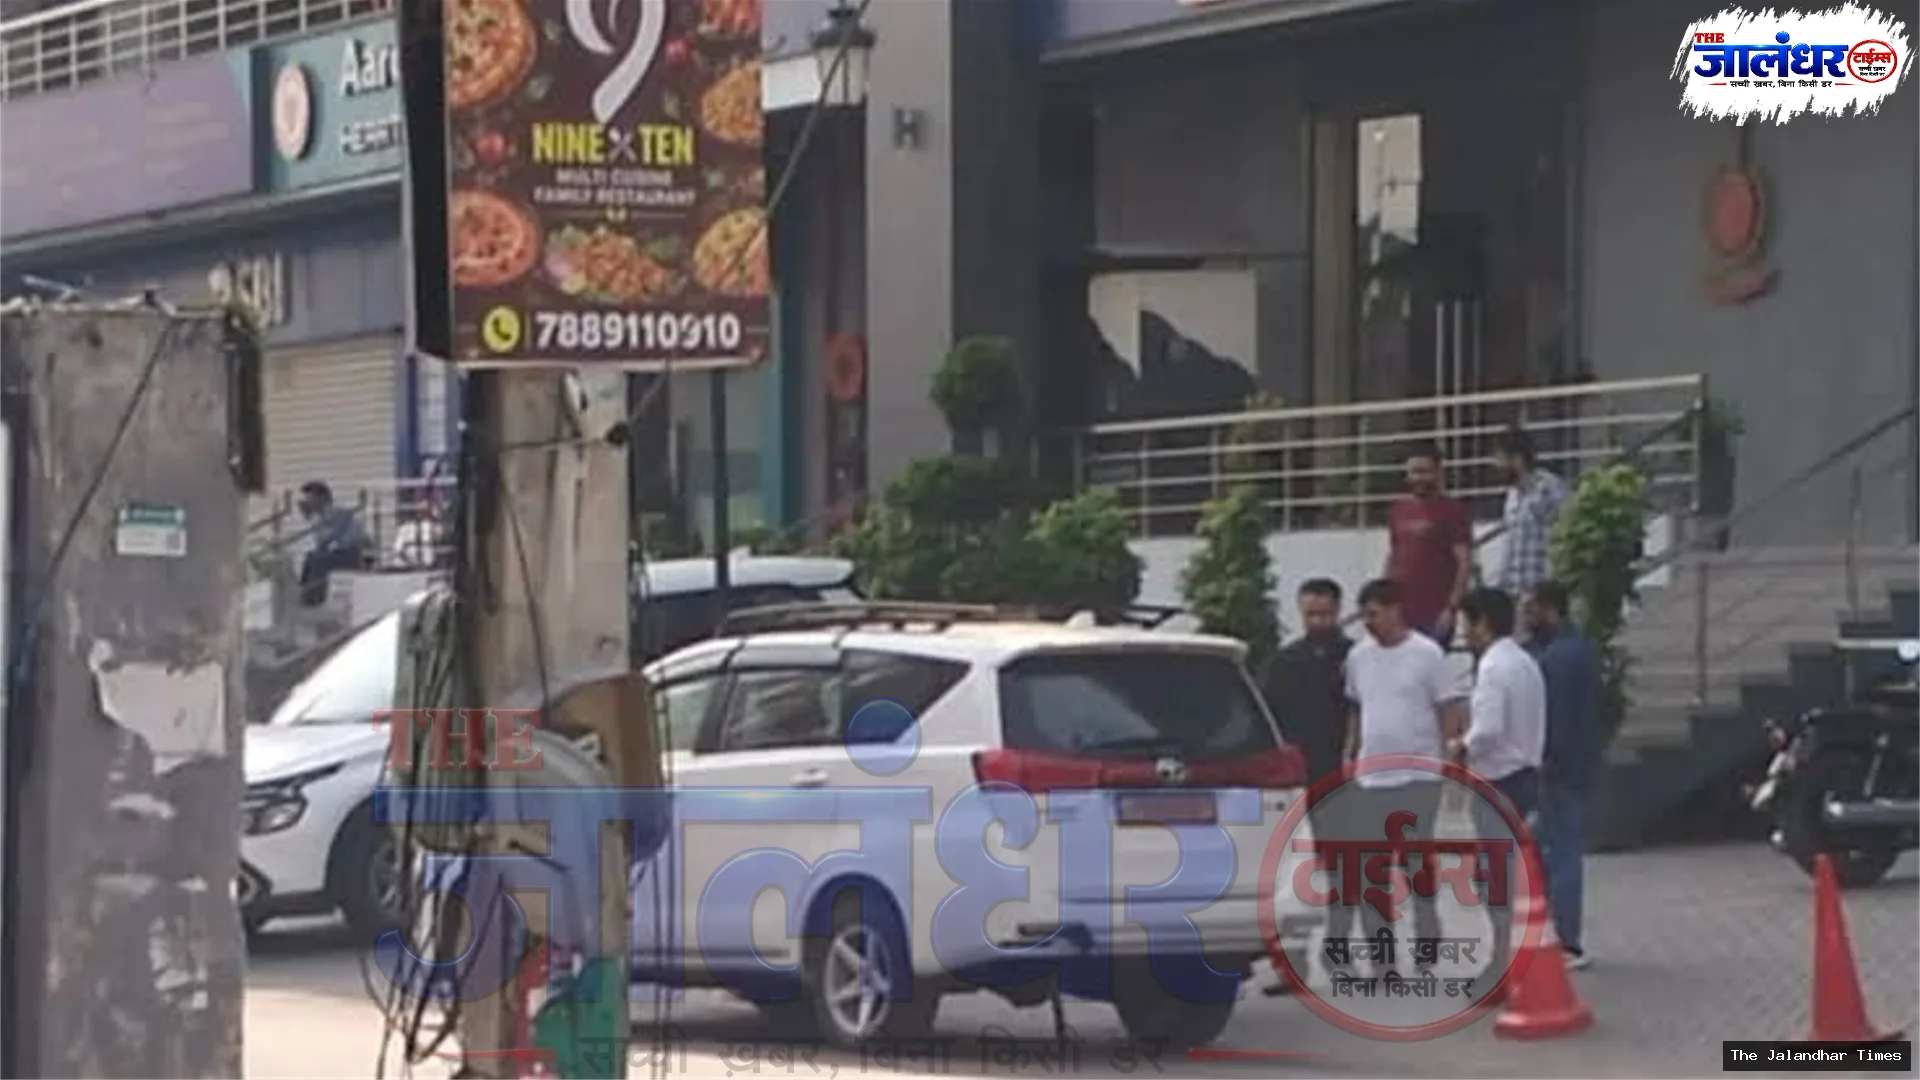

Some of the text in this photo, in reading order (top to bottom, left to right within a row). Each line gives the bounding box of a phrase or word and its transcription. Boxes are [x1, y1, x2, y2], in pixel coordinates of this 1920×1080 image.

[532, 122, 605, 163] NINE
[638, 124, 694, 165] TEN
[536, 311, 741, 349] 7889110910
